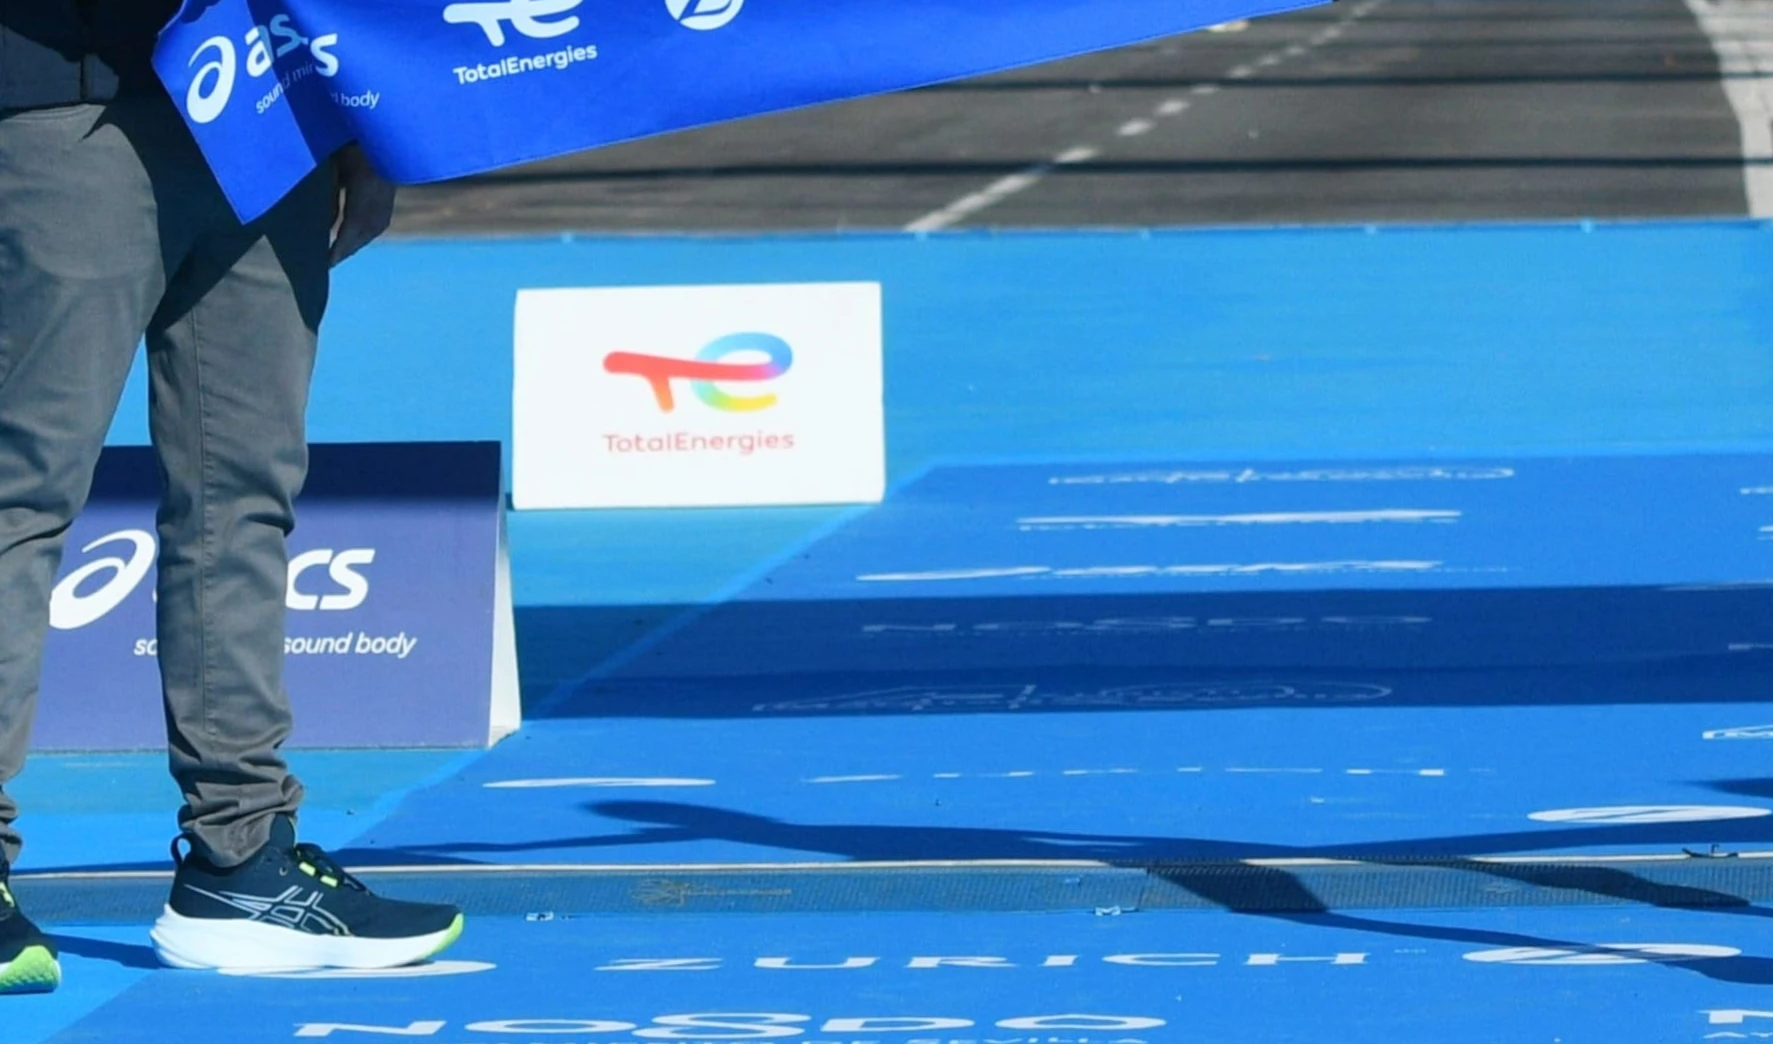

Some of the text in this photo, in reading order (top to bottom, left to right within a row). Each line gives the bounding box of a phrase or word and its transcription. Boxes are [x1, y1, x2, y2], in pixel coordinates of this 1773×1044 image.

[453, 44, 597, 85] TotalEnergies
[602, 431, 796, 456] TotalEnergies
[355, 631, 417, 659] body
[594, 952, 1371, 970] ZURICH
